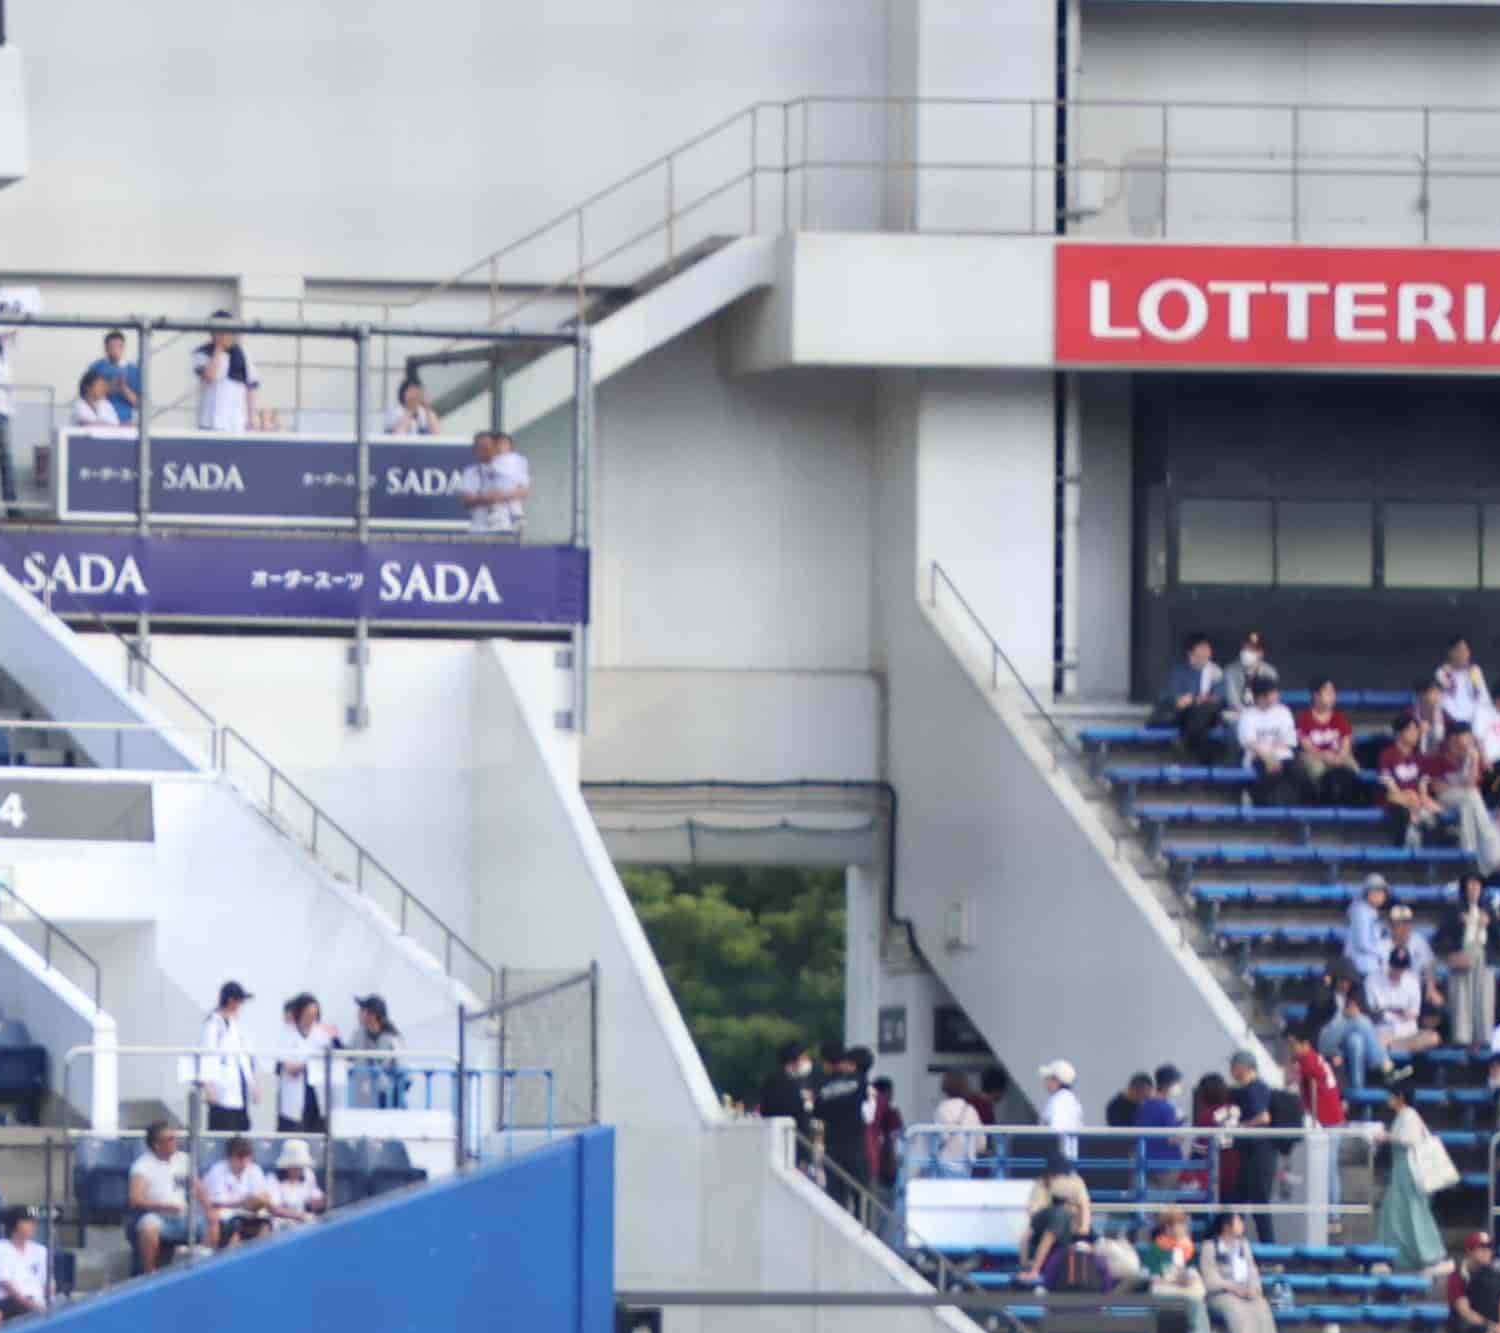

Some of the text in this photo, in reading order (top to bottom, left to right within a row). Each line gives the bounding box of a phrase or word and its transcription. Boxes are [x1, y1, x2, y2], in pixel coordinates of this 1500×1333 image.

[161, 462, 245, 492] SADA
[22, 551, 148, 595] SADA
[379, 562, 502, 603] SADA
